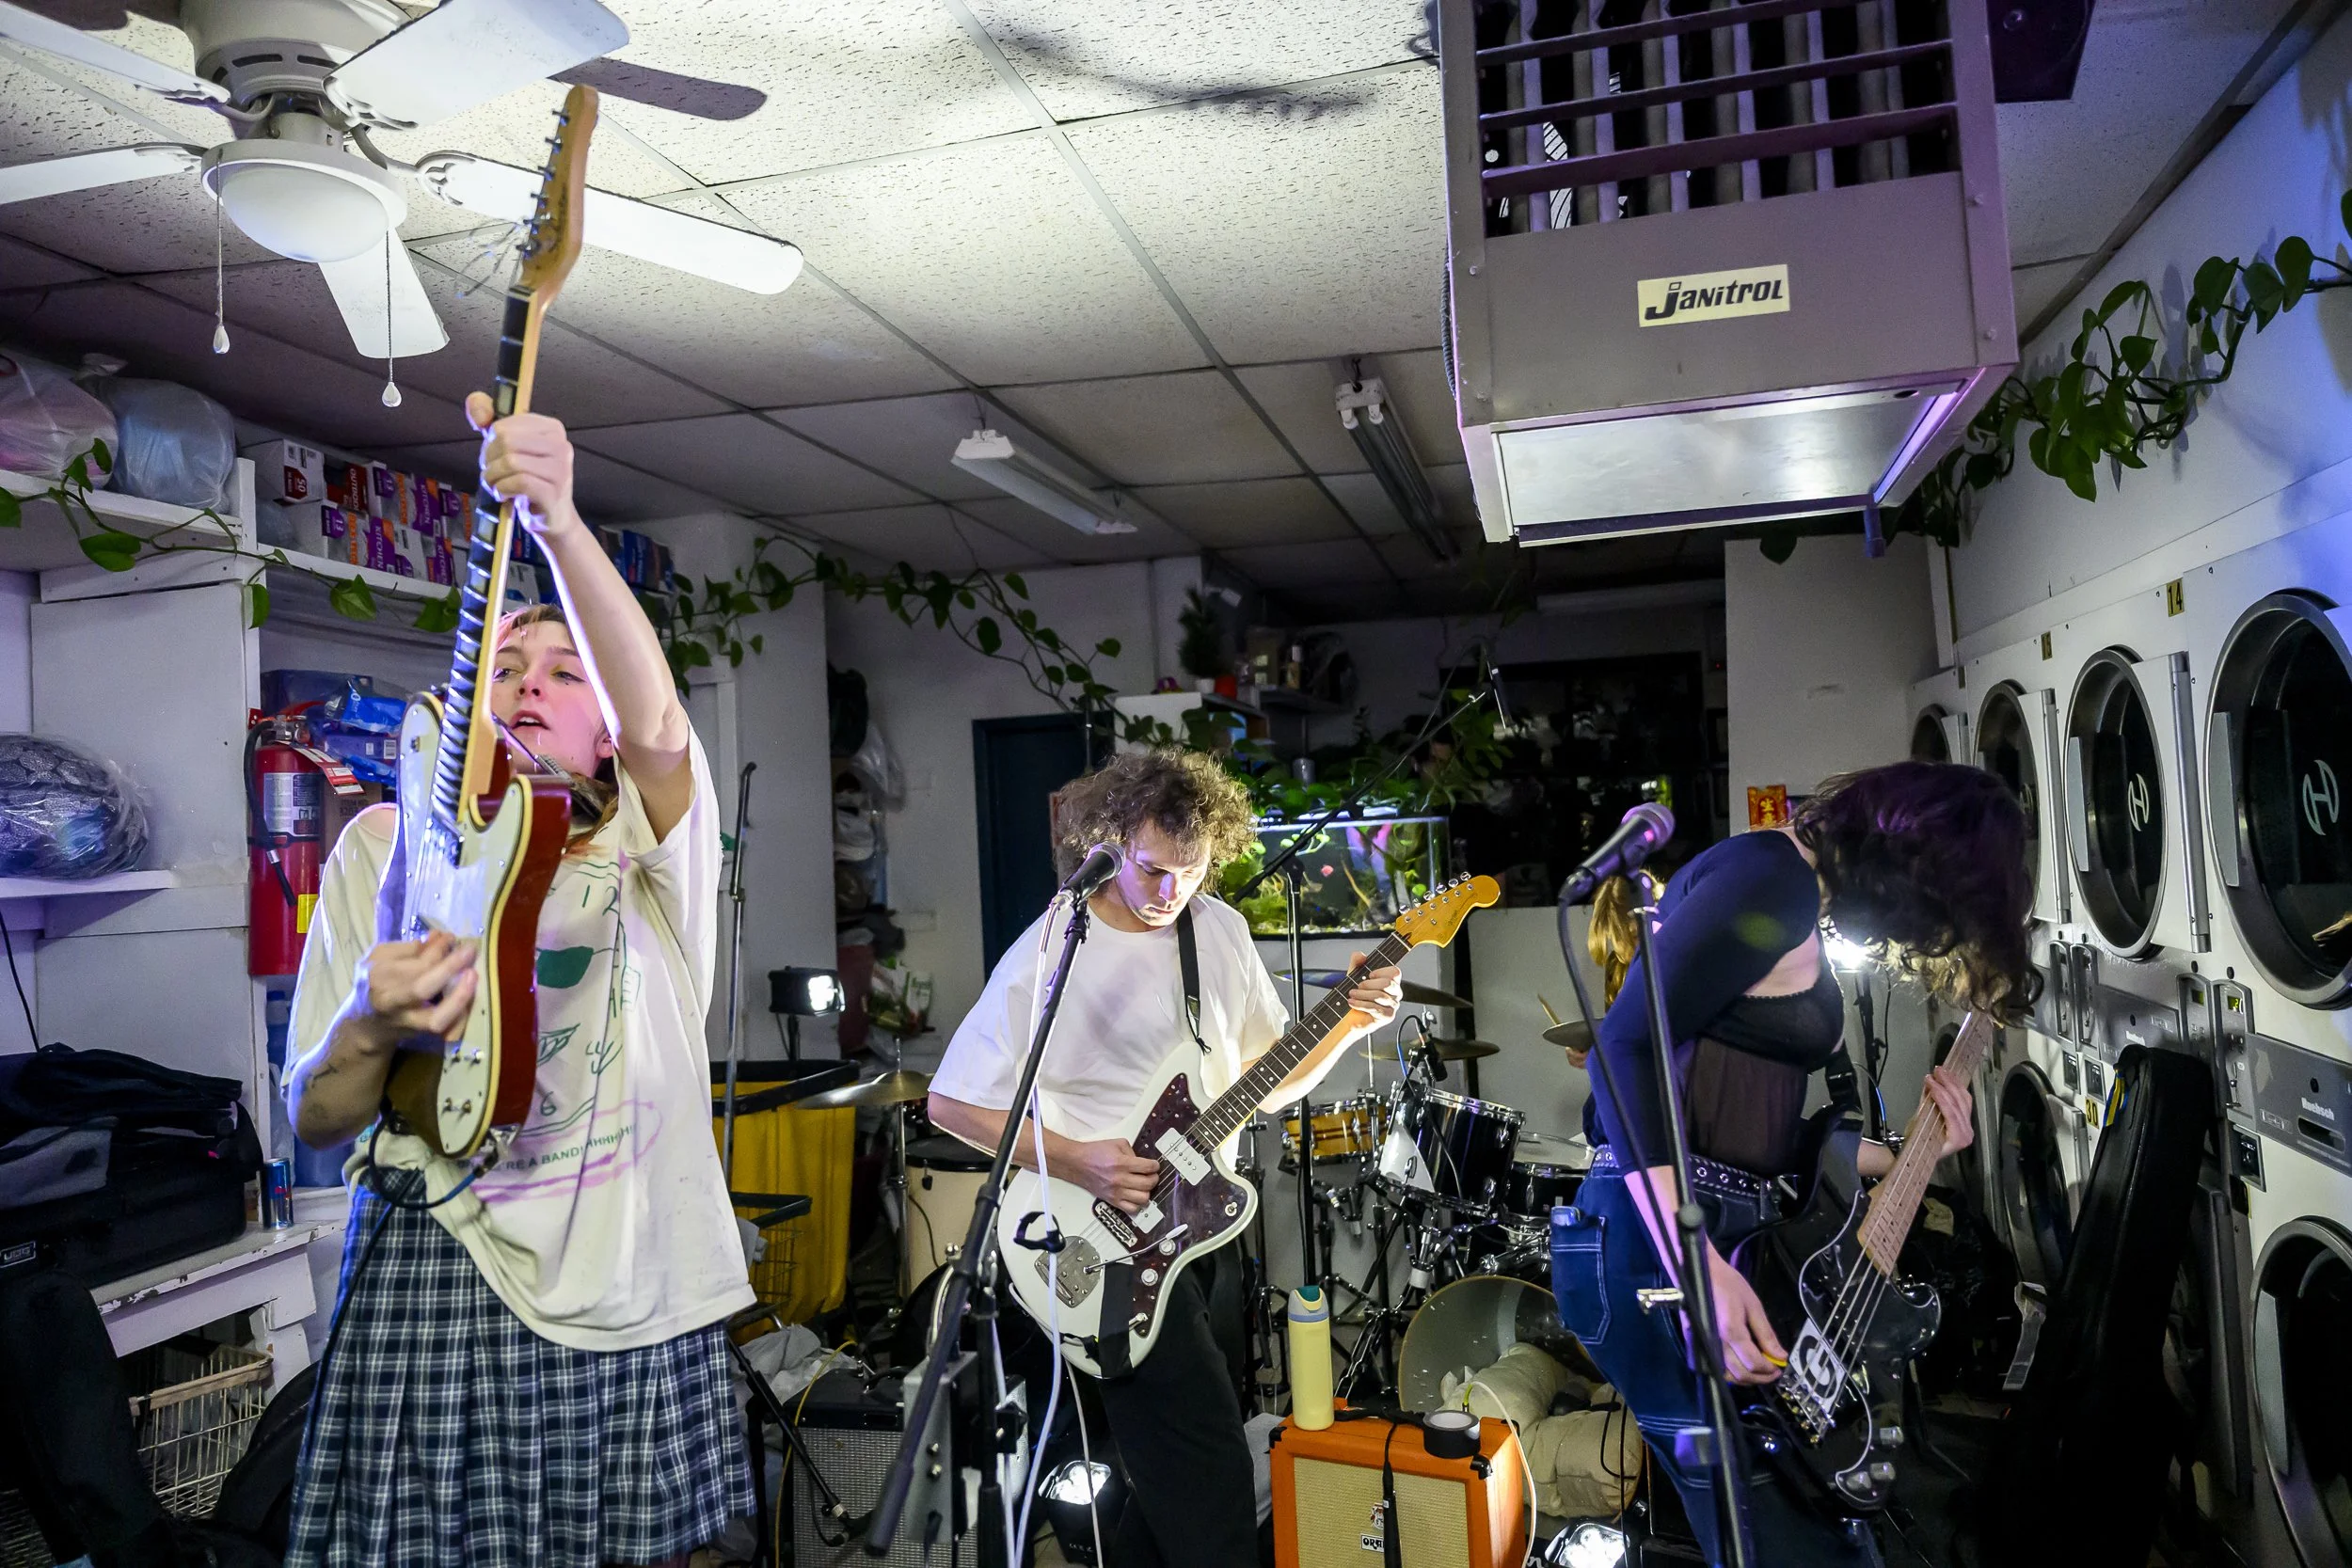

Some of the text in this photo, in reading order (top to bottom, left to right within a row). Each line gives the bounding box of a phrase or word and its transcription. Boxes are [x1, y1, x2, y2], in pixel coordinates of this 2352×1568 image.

[296, 477, 307, 493] 50
[420, 483, 431, 525] KITCHEN
[335, 519, 344, 532] 13
[375, 525, 384, 570] KITCHEN
[437, 545, 449, 585] KITCHEN
[2167, 581, 2183, 614] 14
[2085, 1099, 2099, 1127] 30
